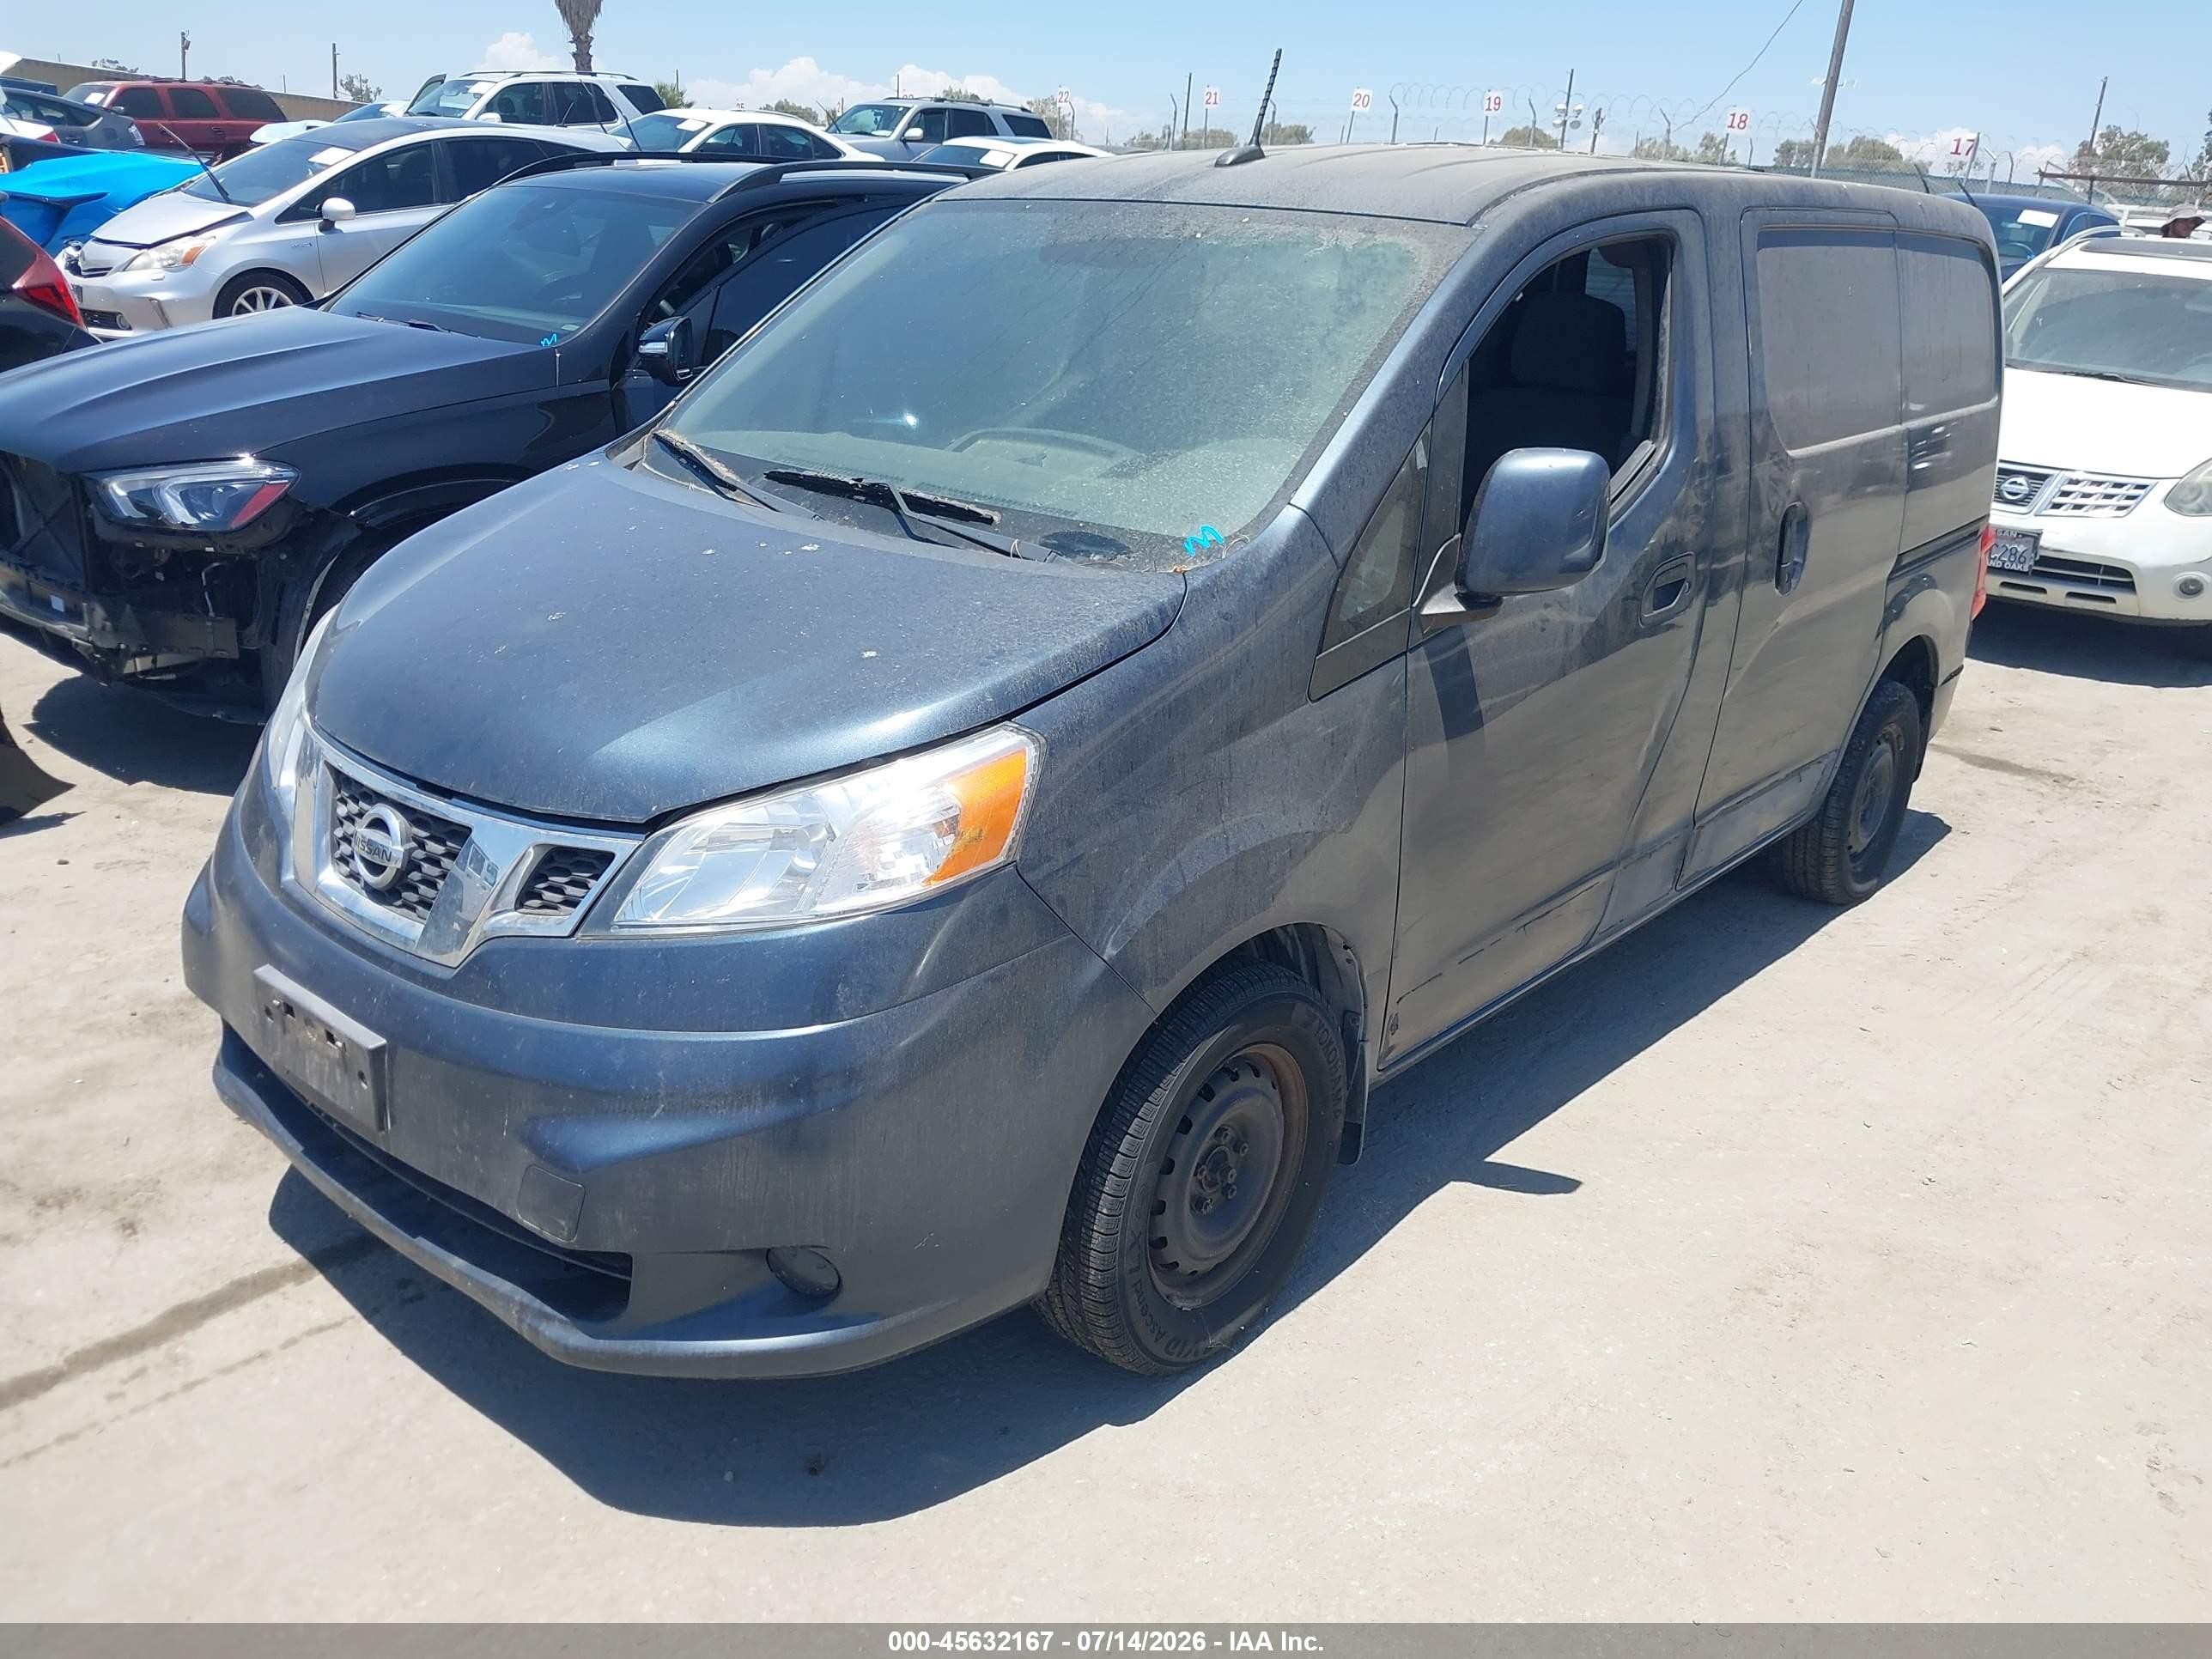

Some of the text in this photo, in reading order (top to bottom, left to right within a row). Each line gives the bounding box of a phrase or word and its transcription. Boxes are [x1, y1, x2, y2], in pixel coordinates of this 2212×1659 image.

[1058, 90, 1070, 103] 22
[1205, 91, 1218, 105] 21
[1353, 93, 1370, 108] 20
[1485, 95, 1501, 112] 19
[1727, 112, 1748, 131] 18
[1950, 137, 1976, 156] 17
[1128, 1229, 1143, 1275] LX
[1132, 1278, 1166, 1344] Ascend
